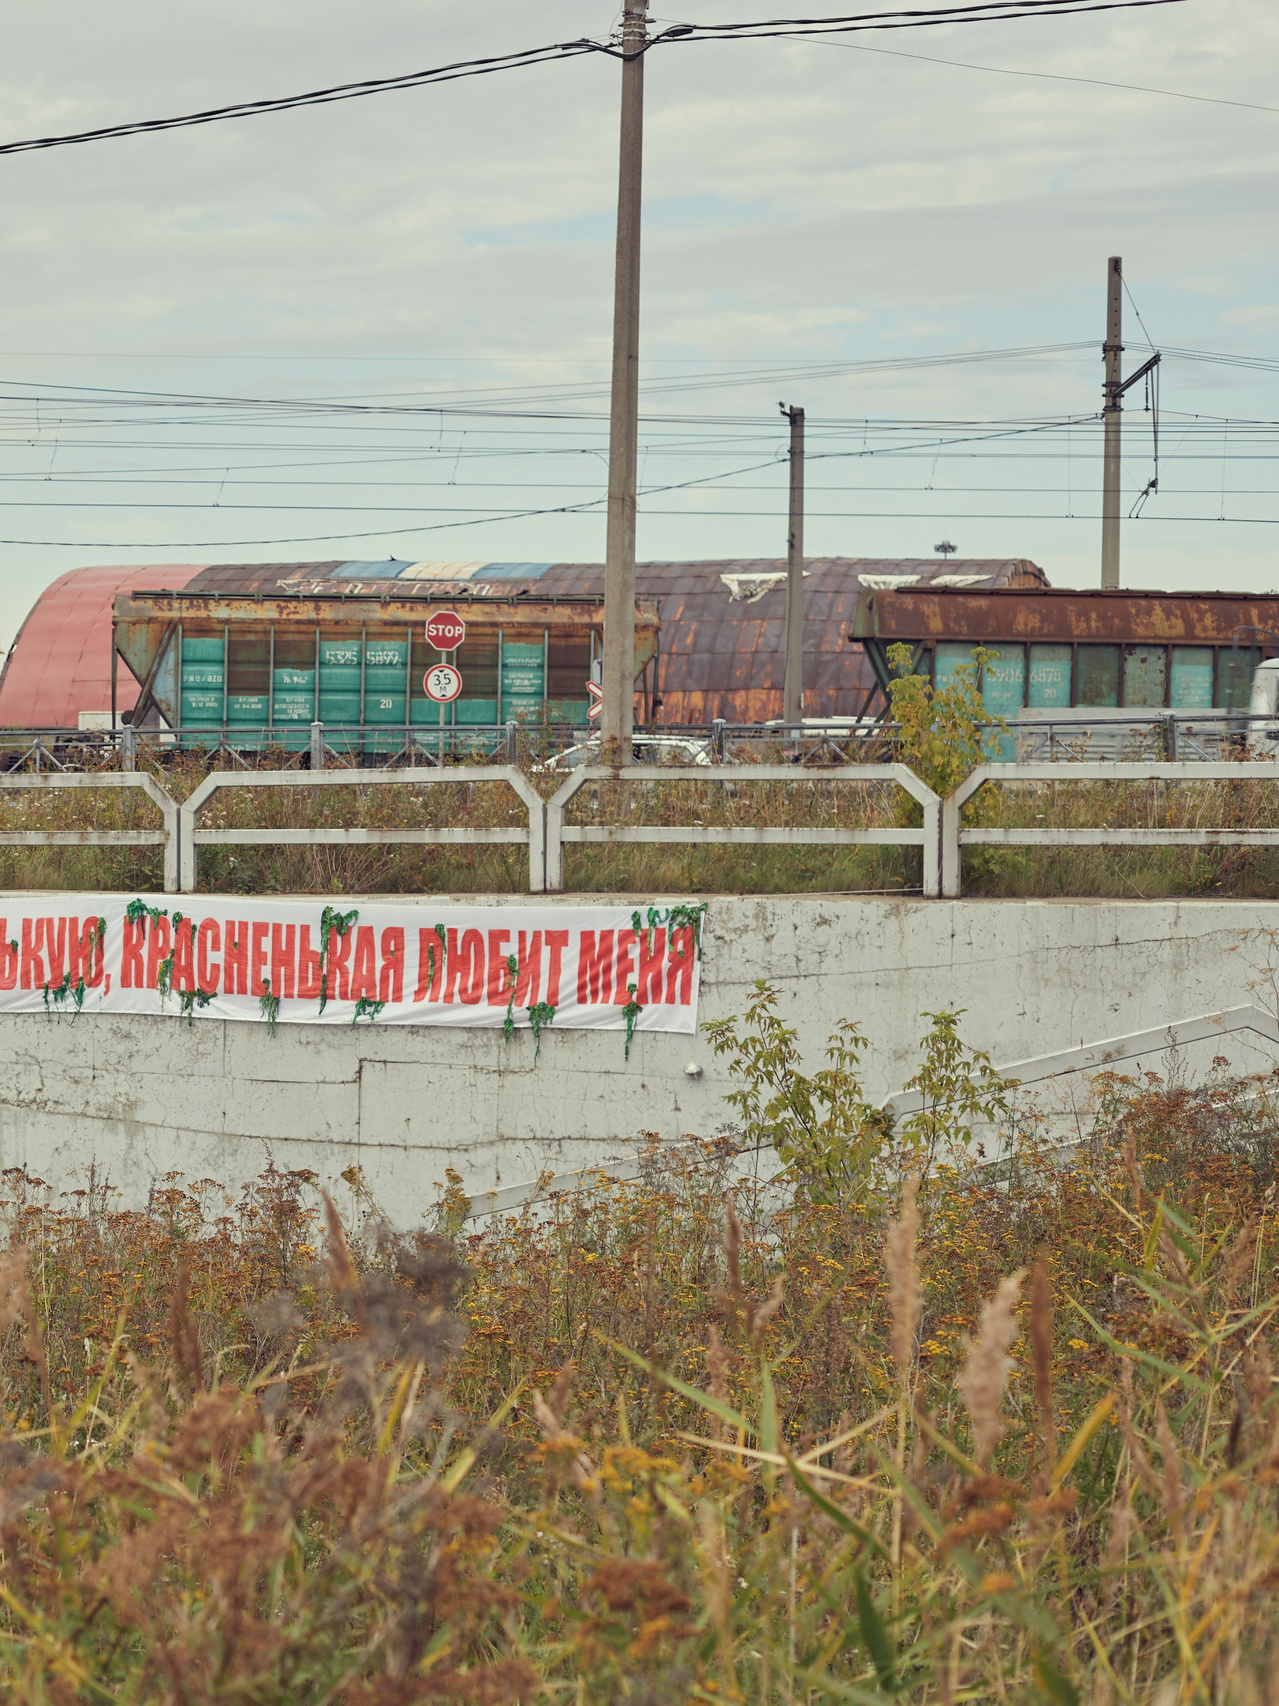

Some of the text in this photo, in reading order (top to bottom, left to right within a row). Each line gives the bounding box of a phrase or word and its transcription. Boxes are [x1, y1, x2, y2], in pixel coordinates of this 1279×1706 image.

[428, 624, 463, 638] STOP
[1044, 688, 1057, 699] 20
[380, 699, 392, 709] 20
[120, 915, 406, 1004] КРАСНЕНЬКАЯ
[412, 926, 570, 1007] ЛЮБИТ
[577, 926, 696, 1006] МЕНЯ
